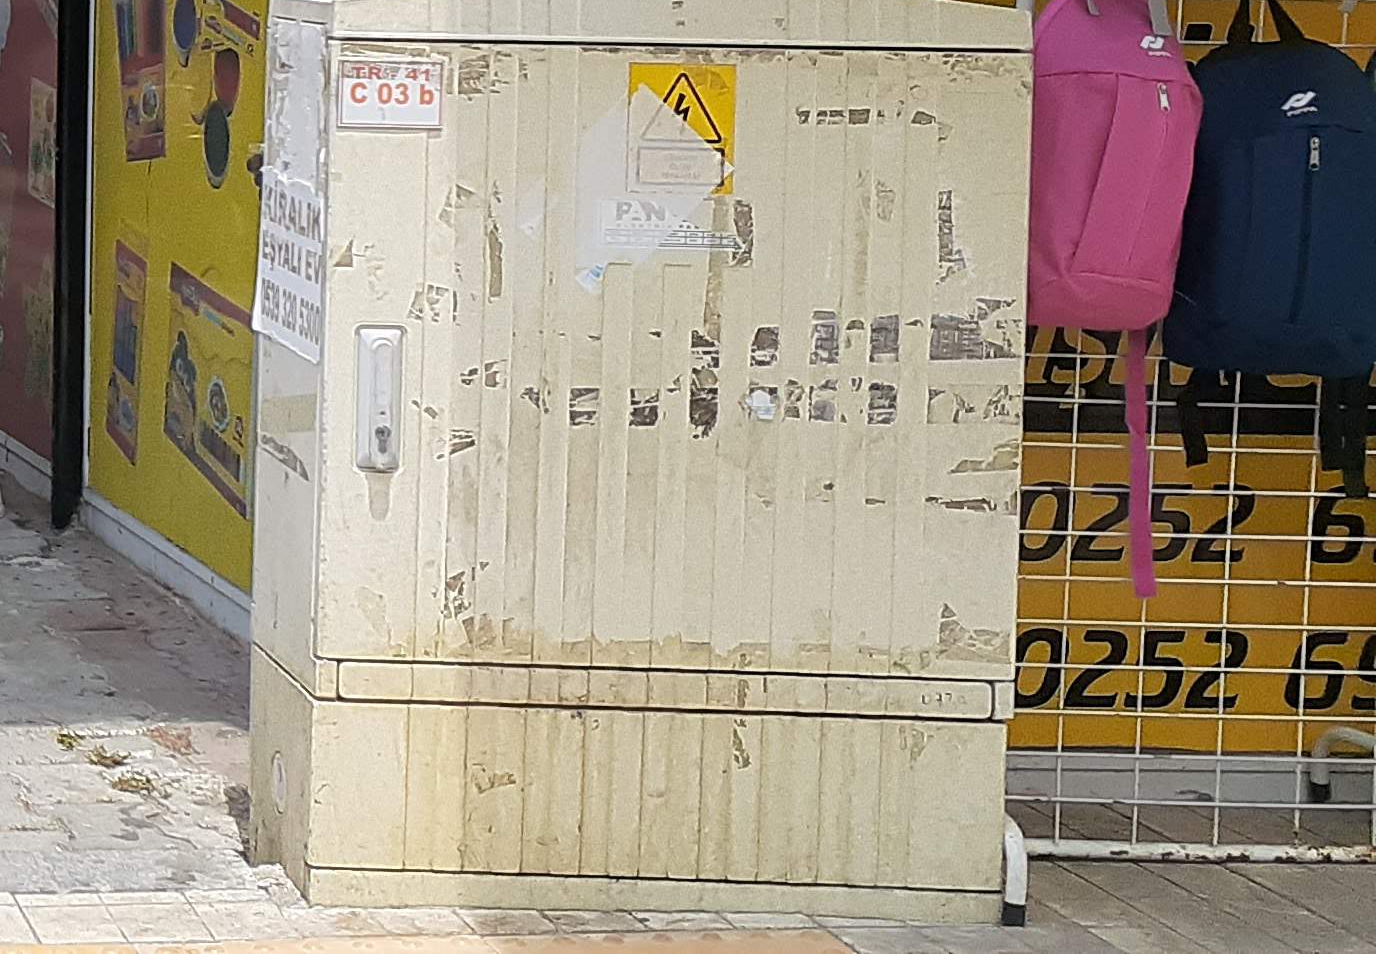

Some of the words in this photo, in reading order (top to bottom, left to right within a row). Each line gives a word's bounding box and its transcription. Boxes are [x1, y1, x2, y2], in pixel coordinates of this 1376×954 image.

[350, 82, 368, 104] C
[377, 82, 410, 105] 03
[419, 84, 435, 106] b
[305, 249, 322, 285] EV
[1018, 482, 1256, 563] 0252
[1308, 486, 1376, 564] 6
[1013, 627, 1250, 710] 0252
